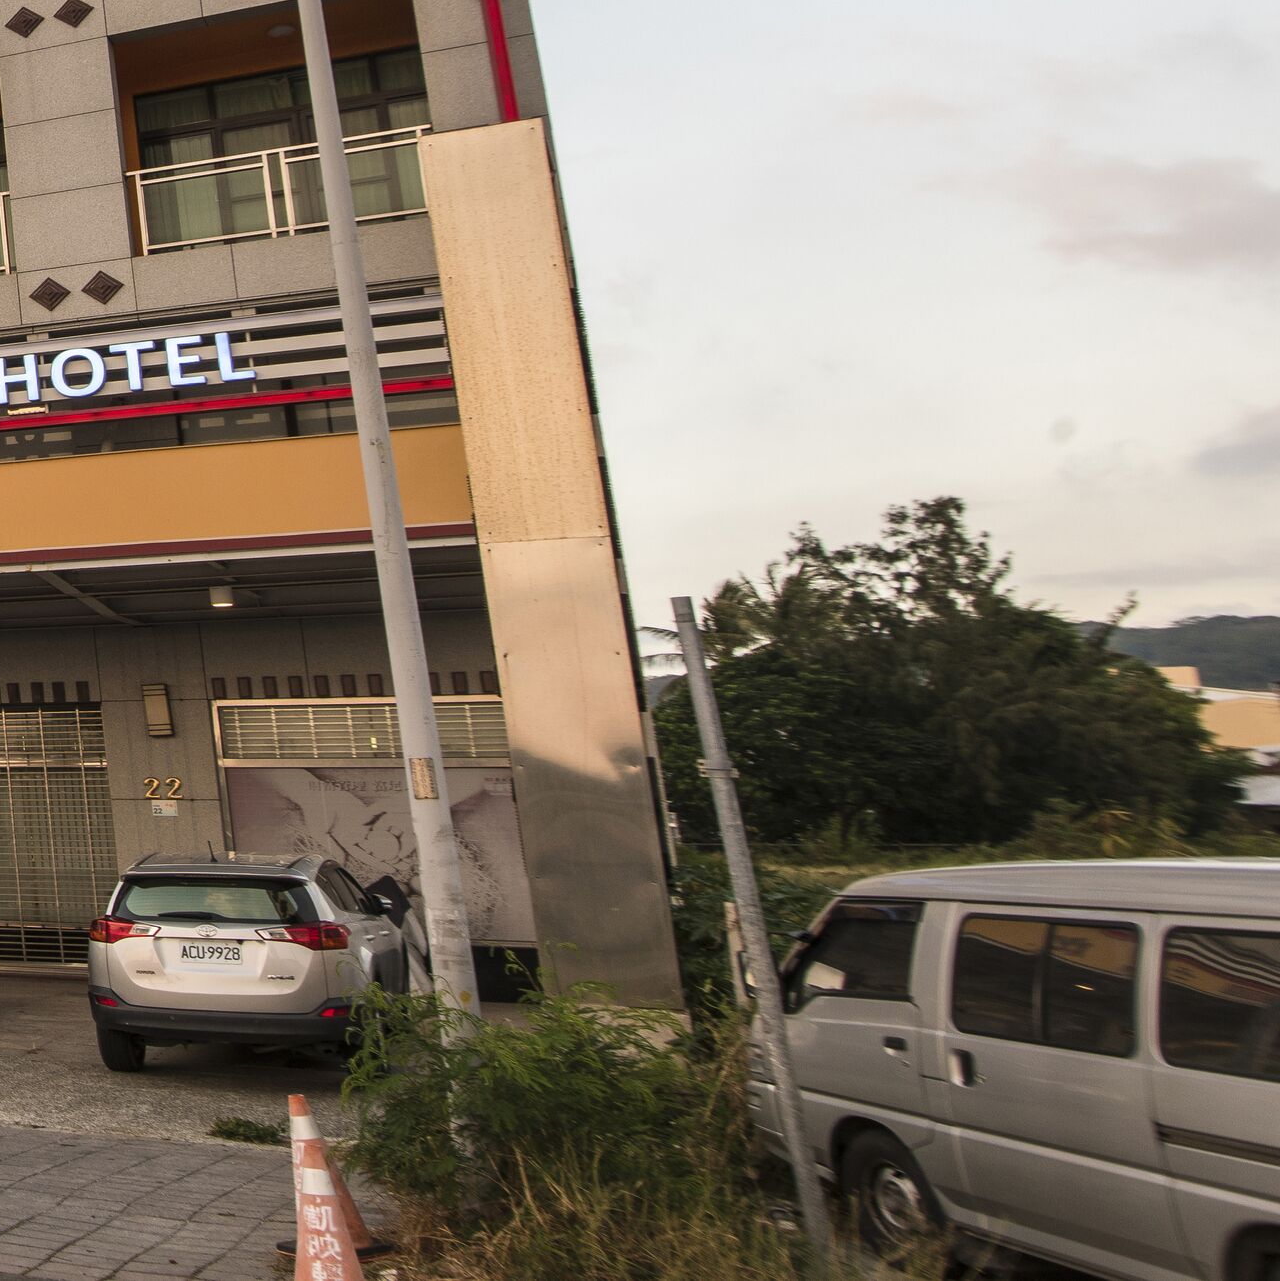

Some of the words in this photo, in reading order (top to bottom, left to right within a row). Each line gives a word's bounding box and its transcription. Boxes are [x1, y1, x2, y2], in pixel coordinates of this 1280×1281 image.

[143, 776, 184, 799] 22
[153, 807, 163, 815] 22
[180, 944, 241, 961] ACU-9928
